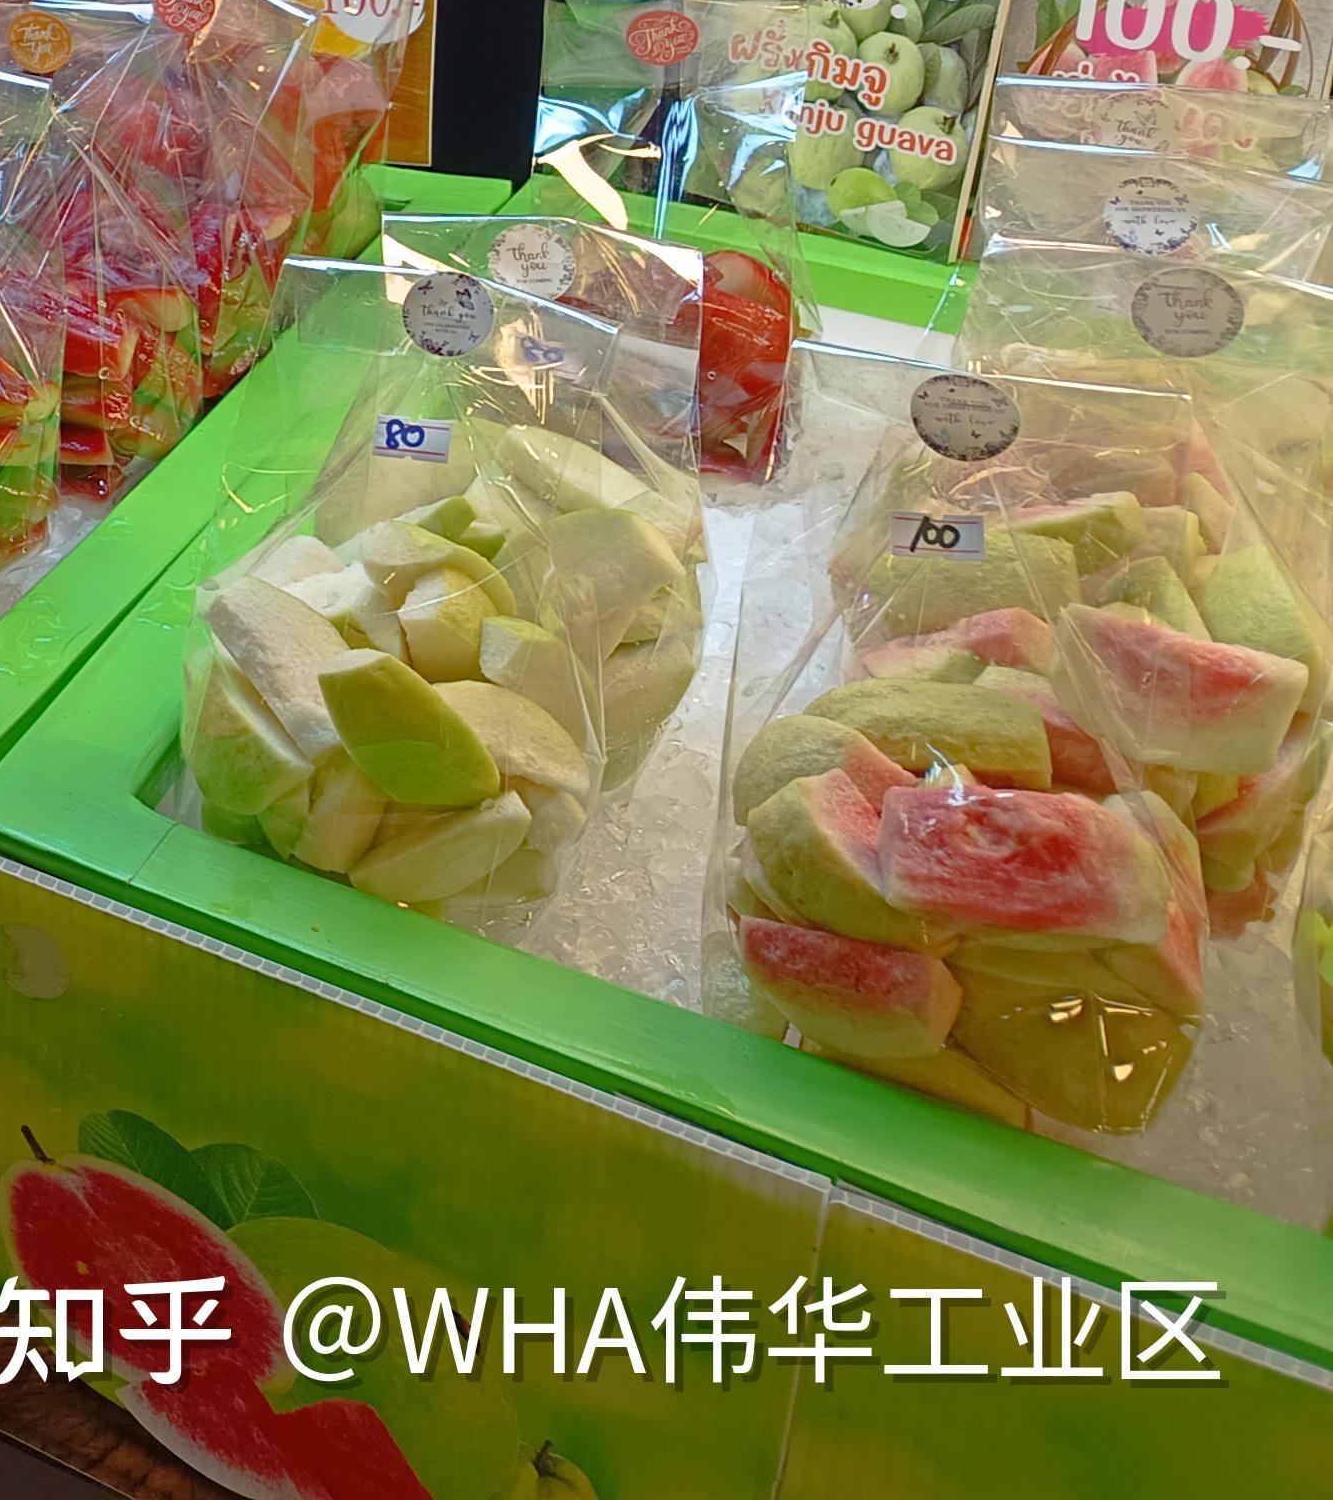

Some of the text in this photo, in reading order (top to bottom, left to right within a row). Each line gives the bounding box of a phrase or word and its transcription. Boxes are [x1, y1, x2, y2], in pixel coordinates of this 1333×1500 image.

[855, 117, 955, 163] guava
[506, 242, 550, 262] thank
[520, 263, 547, 278] you
[1157, 289, 1214, 309] thank
[1174, 310, 1206, 327] you
[385, 419, 425, 450] 80
[911, 516, 961, 552] 100
